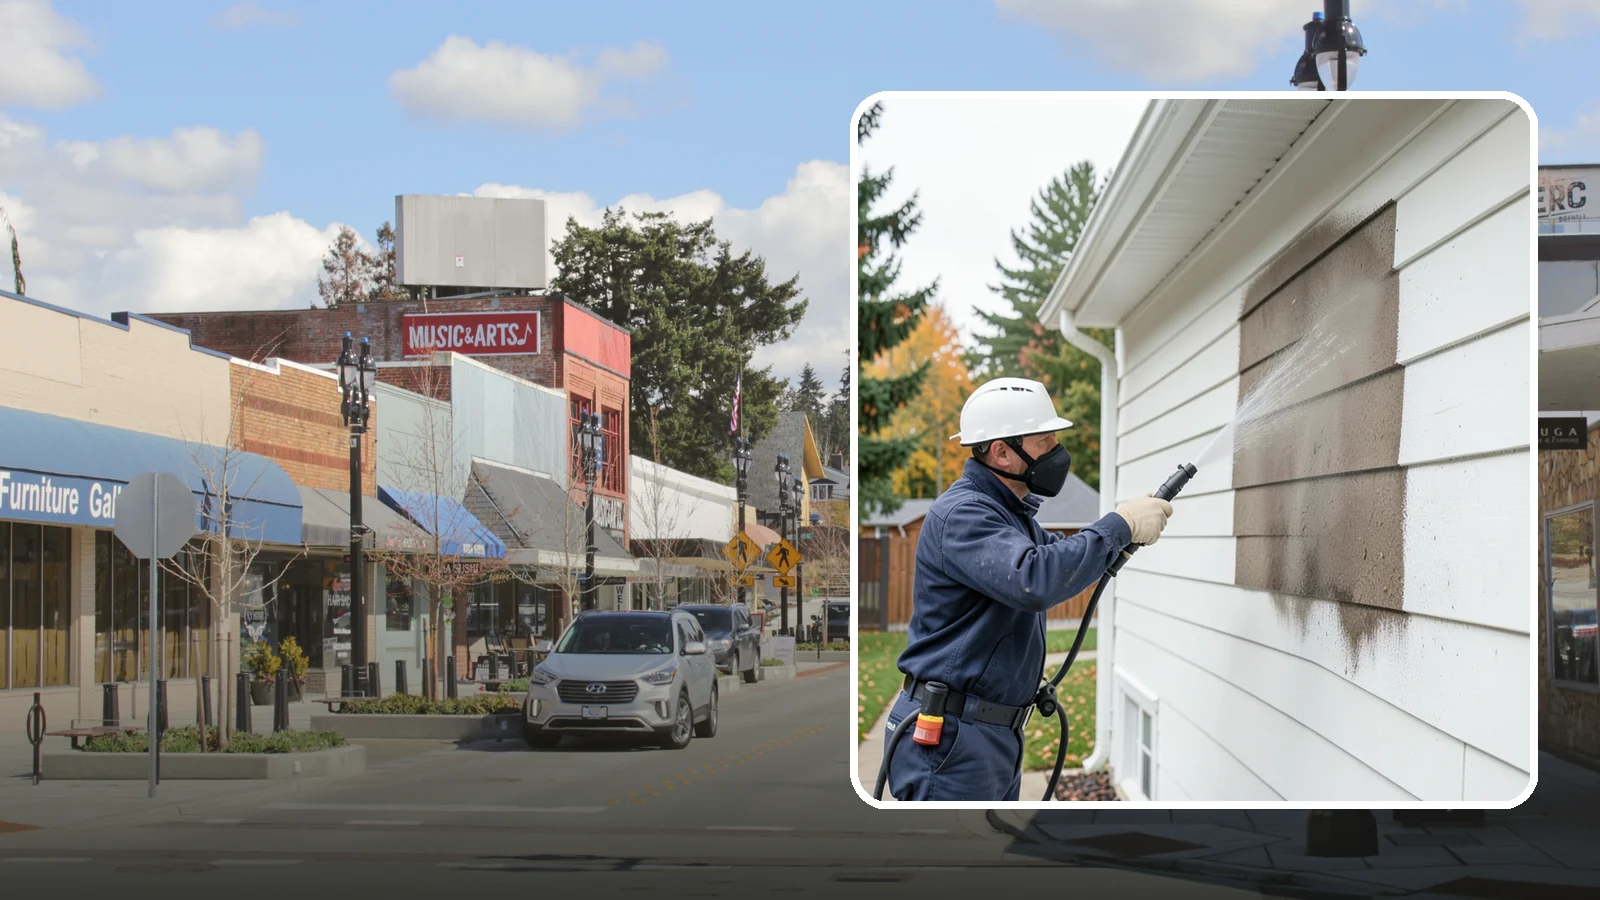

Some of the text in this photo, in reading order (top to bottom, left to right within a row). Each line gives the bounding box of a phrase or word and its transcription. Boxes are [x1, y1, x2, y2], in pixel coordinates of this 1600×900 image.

[1540, 427, 1577, 437] UGA
[0, 471, 122, 519] Furniture Gal
[453, 563, 479, 574] SUSHI
